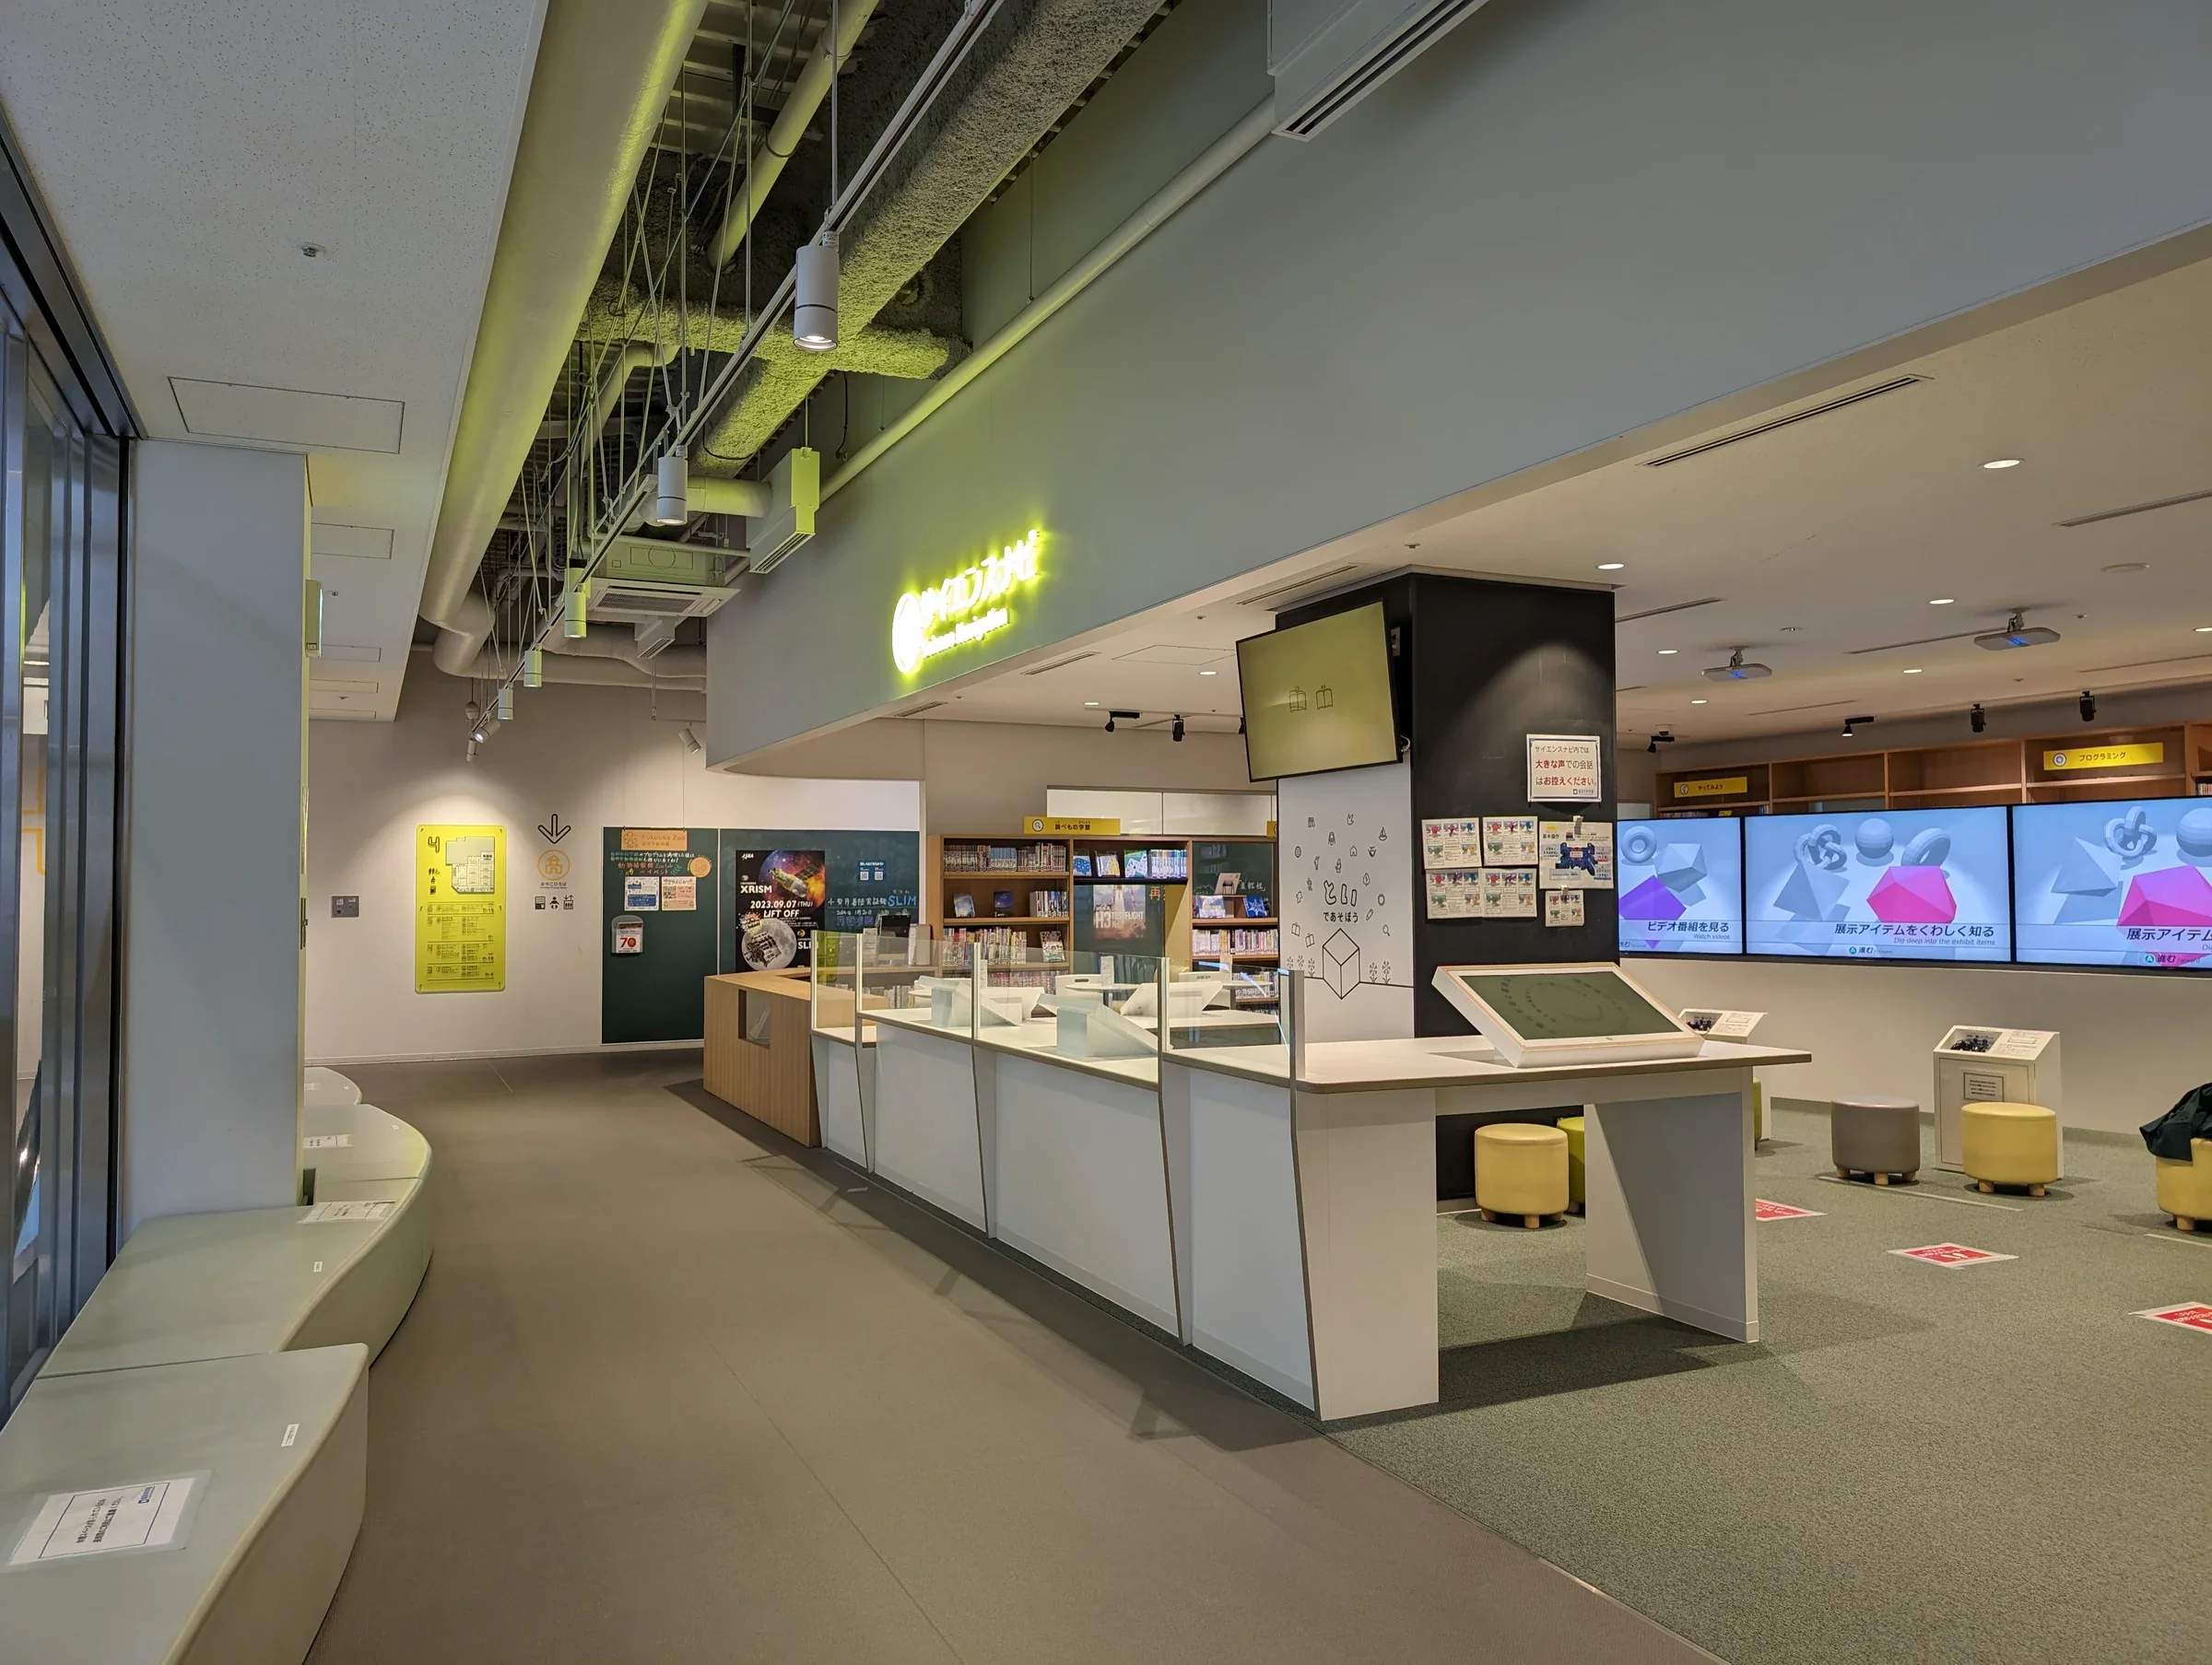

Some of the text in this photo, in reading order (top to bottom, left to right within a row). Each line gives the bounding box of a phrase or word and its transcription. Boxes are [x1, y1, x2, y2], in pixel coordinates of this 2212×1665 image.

[1535, 745, 1589, 754] サイエンスナビ内では
[2079, 752, 2126, 761] プログラミング
[1535, 759, 1594, 769] 大きな声での会話
[1535, 777, 1596, 786] はお控えください。
[428, 836, 441, 853] 4
[740, 885, 772, 894] XRISM
[1324, 880, 1358, 907] とい
[750, 900, 796, 909] 2023.09.07
[888, 895, 917, 907] SLIM
[763, 909, 800, 918] LIFT OFF
[1125, 911, 1144, 920] FLIGHT
[1324, 911, 1359, 922] であそぼう
[1095, 911, 1112, 929] H3
[1648, 921, 1729, 932] ビデオ番組を見る
[1834, 923, 1994, 937] 展示アイテムをくわしく知る
[2157, 955, 2176, 963] 進む
